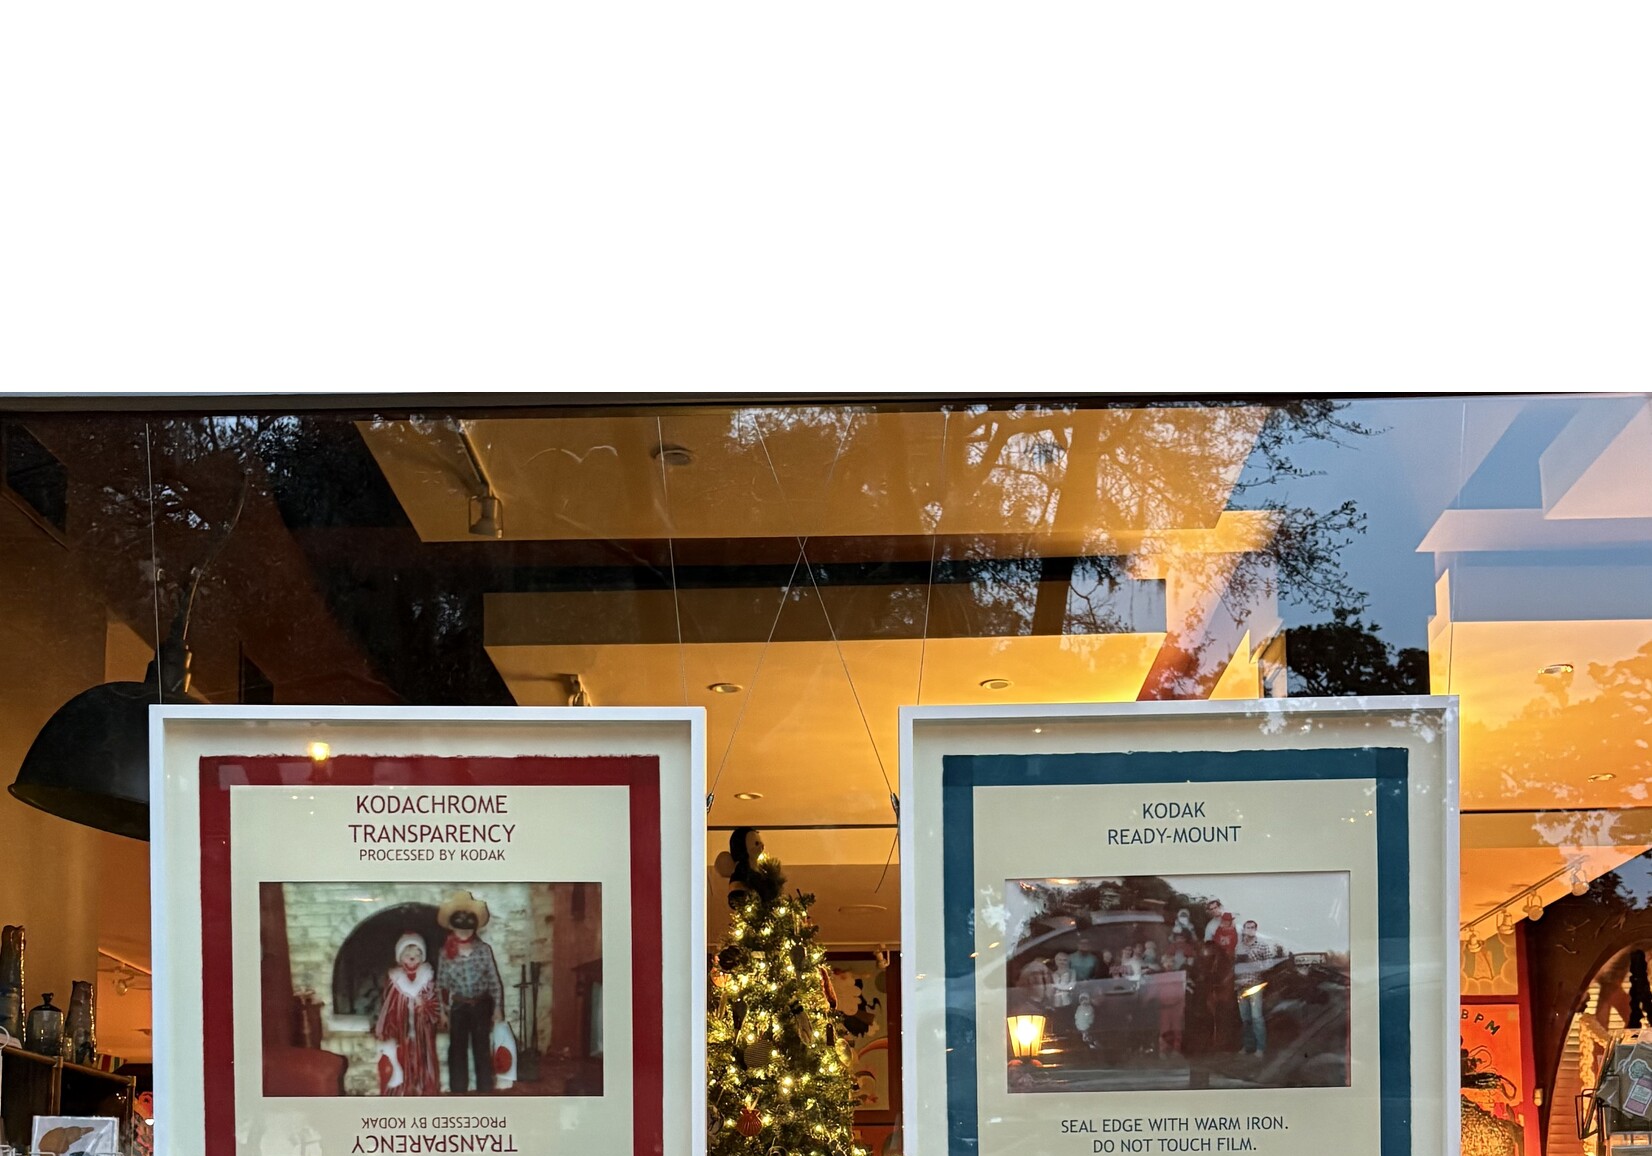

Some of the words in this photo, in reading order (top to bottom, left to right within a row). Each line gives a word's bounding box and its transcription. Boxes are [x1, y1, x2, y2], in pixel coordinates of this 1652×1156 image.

[356, 795, 508, 814] KODACHROME
[1142, 801, 1206, 820] KODAK
[348, 824, 516, 843] TRANSPARENCY
[1107, 826, 1242, 846] READY-MOUNT
[359, 848, 435, 862] PROCESSED
[439, 848, 456, 861] BY
[460, 848, 506, 861] KODAK
[361, 1117, 406, 1130] KODAK
[410, 1116, 427, 1129] BY
[431, 1116, 507, 1129] PROCESSED
[1061, 1119, 1098, 1134] SEAL
[1102, 1118, 1143, 1133] EDGE
[1148, 1117, 1189, 1132] WITH
[1194, 1116, 1241, 1131] WARM
[1246, 1115, 1289, 1130] IRON.
[351, 1134, 519, 1154] TRANSPARENCY
[1093, 1139, 1115, 1153] DO
[1120, 1138, 1153, 1153] NOT
[1157, 1137, 1211, 1152] TOUCH
[1217, 1137, 1257, 1152] FILM.
